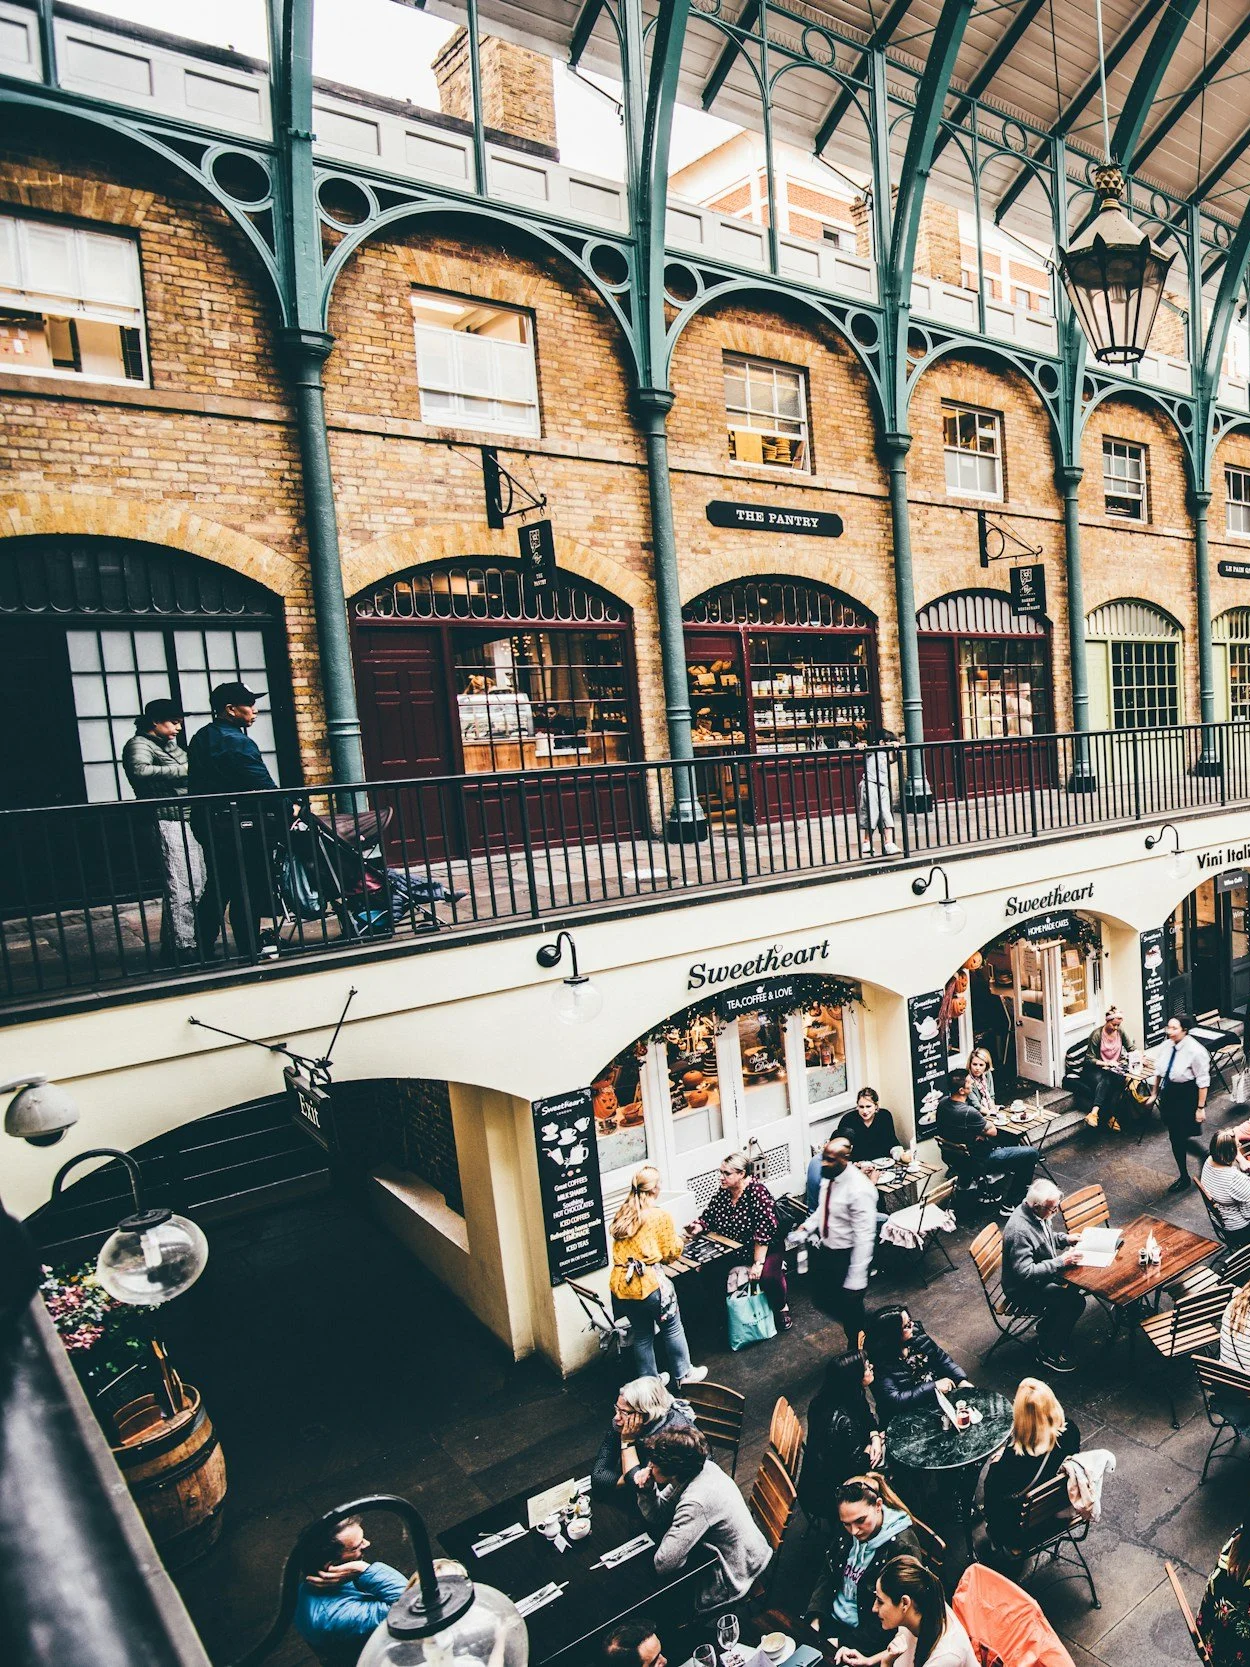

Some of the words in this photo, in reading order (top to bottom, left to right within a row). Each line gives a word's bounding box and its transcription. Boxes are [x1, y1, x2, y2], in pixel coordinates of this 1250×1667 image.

[736, 509, 764, 523] THE
[769, 513, 819, 528] PANTRY
[1197, 850, 1222, 869] Vini
[1005, 882, 1094, 917] Sweetheart
[1028, 924, 1042, 936] HOME
[1042, 921, 1055, 932] MADE
[1055, 918, 1069, 928] CAKES
[687, 939, 830, 990] Sweetheart
[768, 990, 774, 1000] &
[775, 986, 793, 999] LOVE
[298, 1091, 321, 1129] Exit
[541, 1097, 585, 1116] Sweetheart
[567, 1175, 588, 1188] COFFEES
[553, 1208, 564, 1219] HOT
[563, 1199, 595, 1215] CHOCOLATES
[560, 1219, 571, 1228] ICED
[566, 1243, 577, 1253] ICED
[577, 1239, 590, 1249] TEAS
